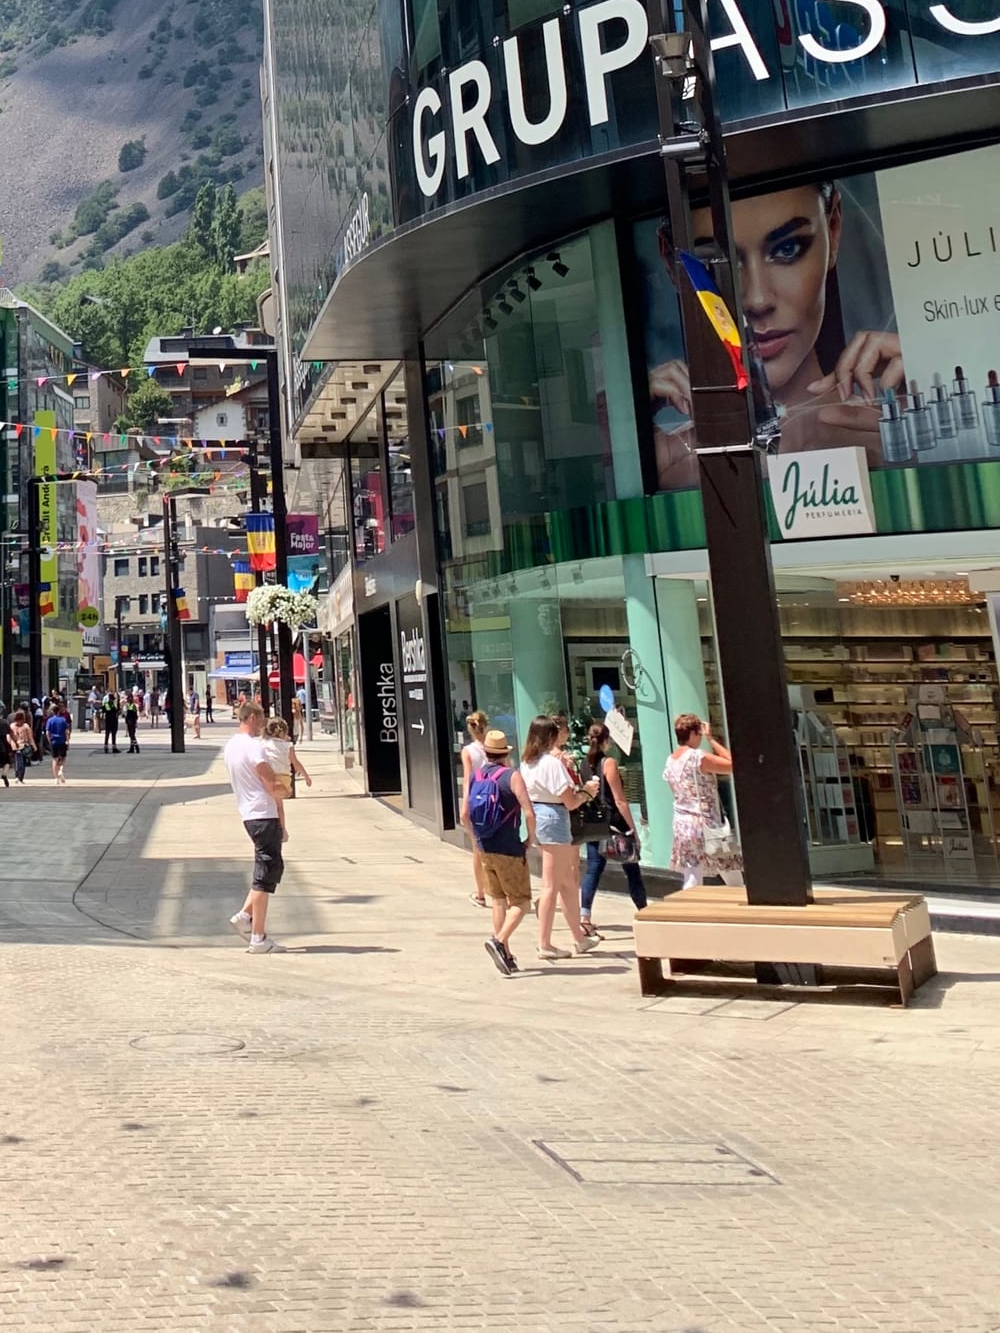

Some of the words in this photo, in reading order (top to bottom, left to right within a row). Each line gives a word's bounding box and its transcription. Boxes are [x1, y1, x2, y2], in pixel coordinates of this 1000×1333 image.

[782, 461, 859, 530] Júlia
[290, 533, 314, 542] Festa
[290, 538, 314, 550] Major
[81, 613, 98, 621] 24h
[376, 662, 398, 743] Bershka
